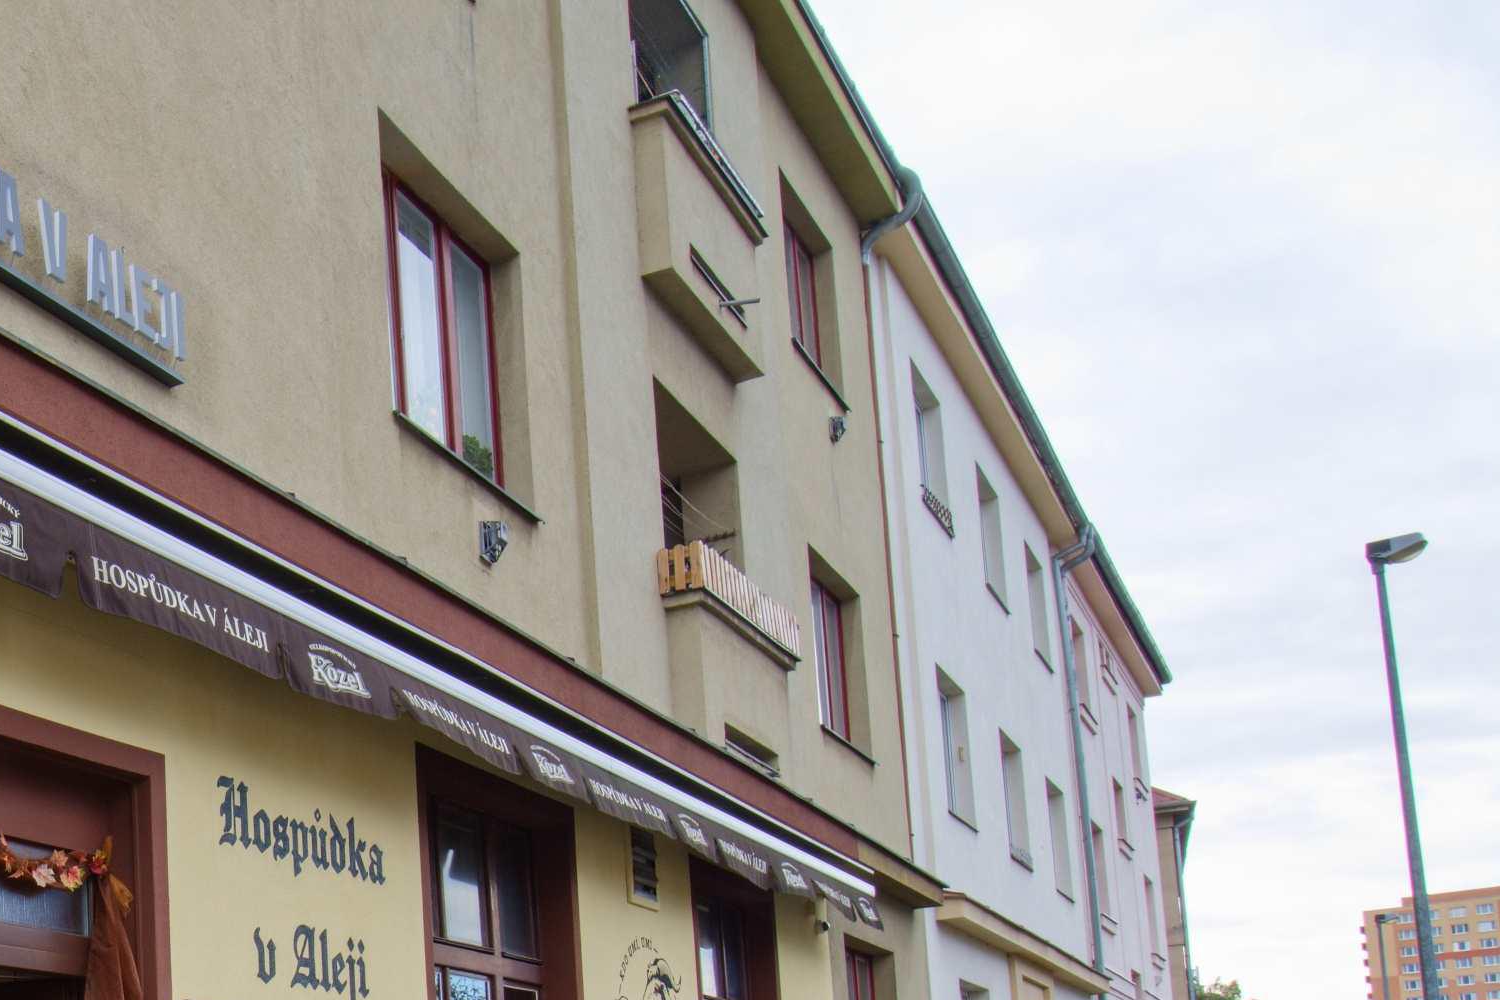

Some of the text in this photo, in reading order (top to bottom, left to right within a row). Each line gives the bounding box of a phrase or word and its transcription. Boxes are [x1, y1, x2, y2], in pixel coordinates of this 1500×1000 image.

[37, 196, 68, 284] V
[86, 232, 187, 362] ALEJI
[91, 555, 206, 623] HOSPŮDKA
[205, 603, 217, 626] V
[307, 652, 372, 699] Kozel
[216, 774, 386, 887] Hospůdka
